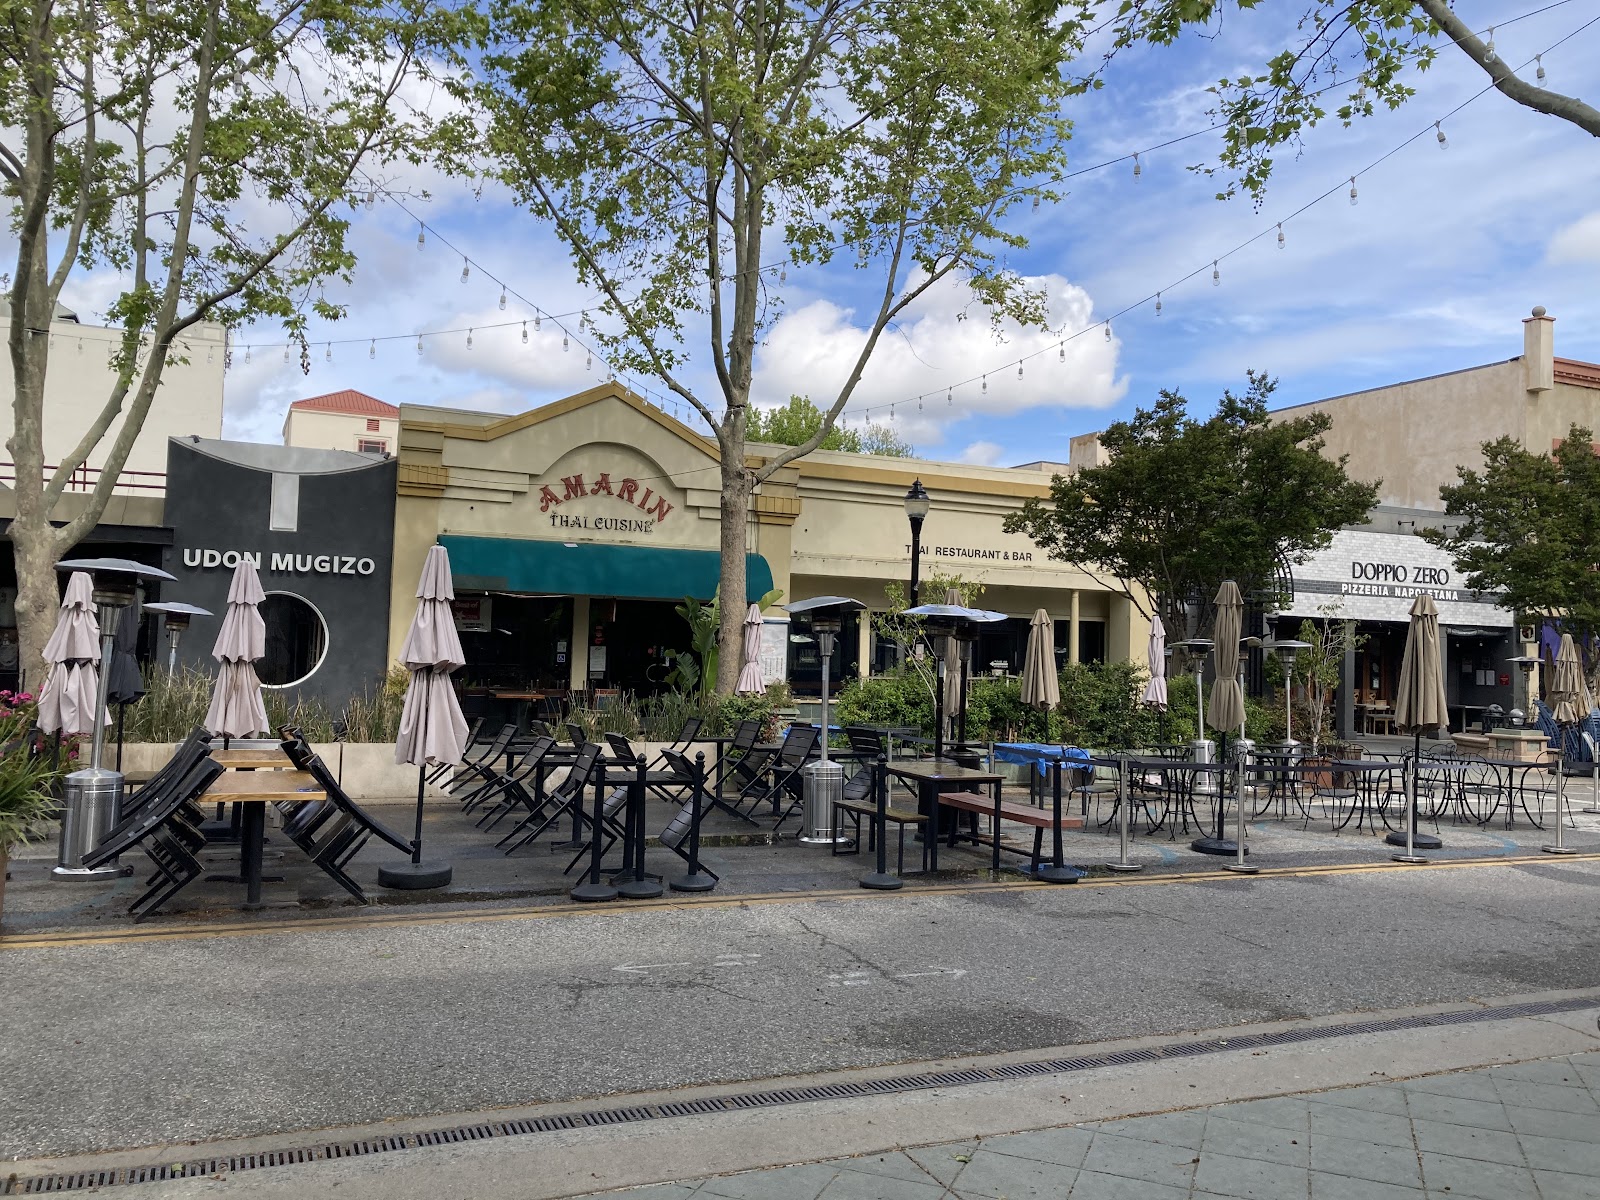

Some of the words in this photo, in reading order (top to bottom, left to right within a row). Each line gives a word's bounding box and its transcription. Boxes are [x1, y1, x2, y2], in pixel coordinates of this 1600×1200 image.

[539, 473, 674, 522] AMARIN
[550, 511, 589, 528] THAI
[594, 516, 655, 534] CUISINE
[183, 548, 262, 569] UDON
[270, 552, 375, 575] MUGIZO
[905, 544, 929, 555] TAI
[935, 546, 1001, 559] RESTAURANT
[1003, 551, 1010, 560] &
[1012, 551, 1032, 561] BAR
[1352, 561, 1407, 582] DOPPIO
[1412, 566, 1449, 585] ZERO
[1341, 583, 1389, 597] PIZZERIA
